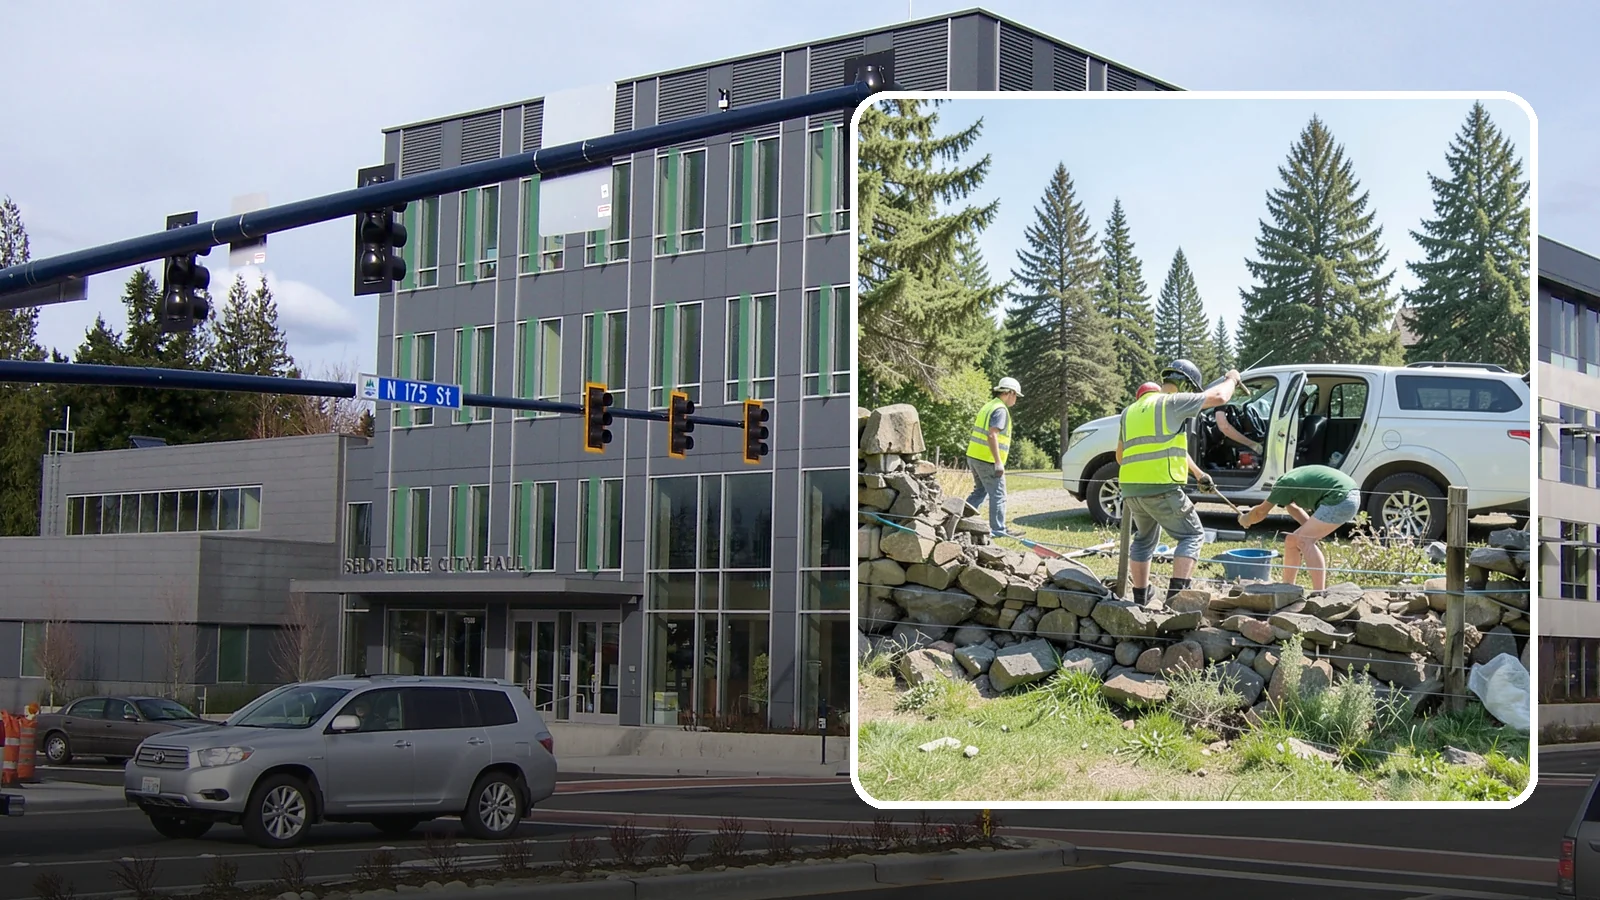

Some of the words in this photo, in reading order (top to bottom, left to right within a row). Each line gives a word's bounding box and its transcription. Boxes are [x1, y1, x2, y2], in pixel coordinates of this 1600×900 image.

[387, 380, 396, 400] N
[405, 382, 428, 403] 175
[436, 386, 452, 406] St
[344, 556, 432, 574] SHORELINE
[438, 556, 476, 573] CITY
[484, 555, 526, 572] HALL
